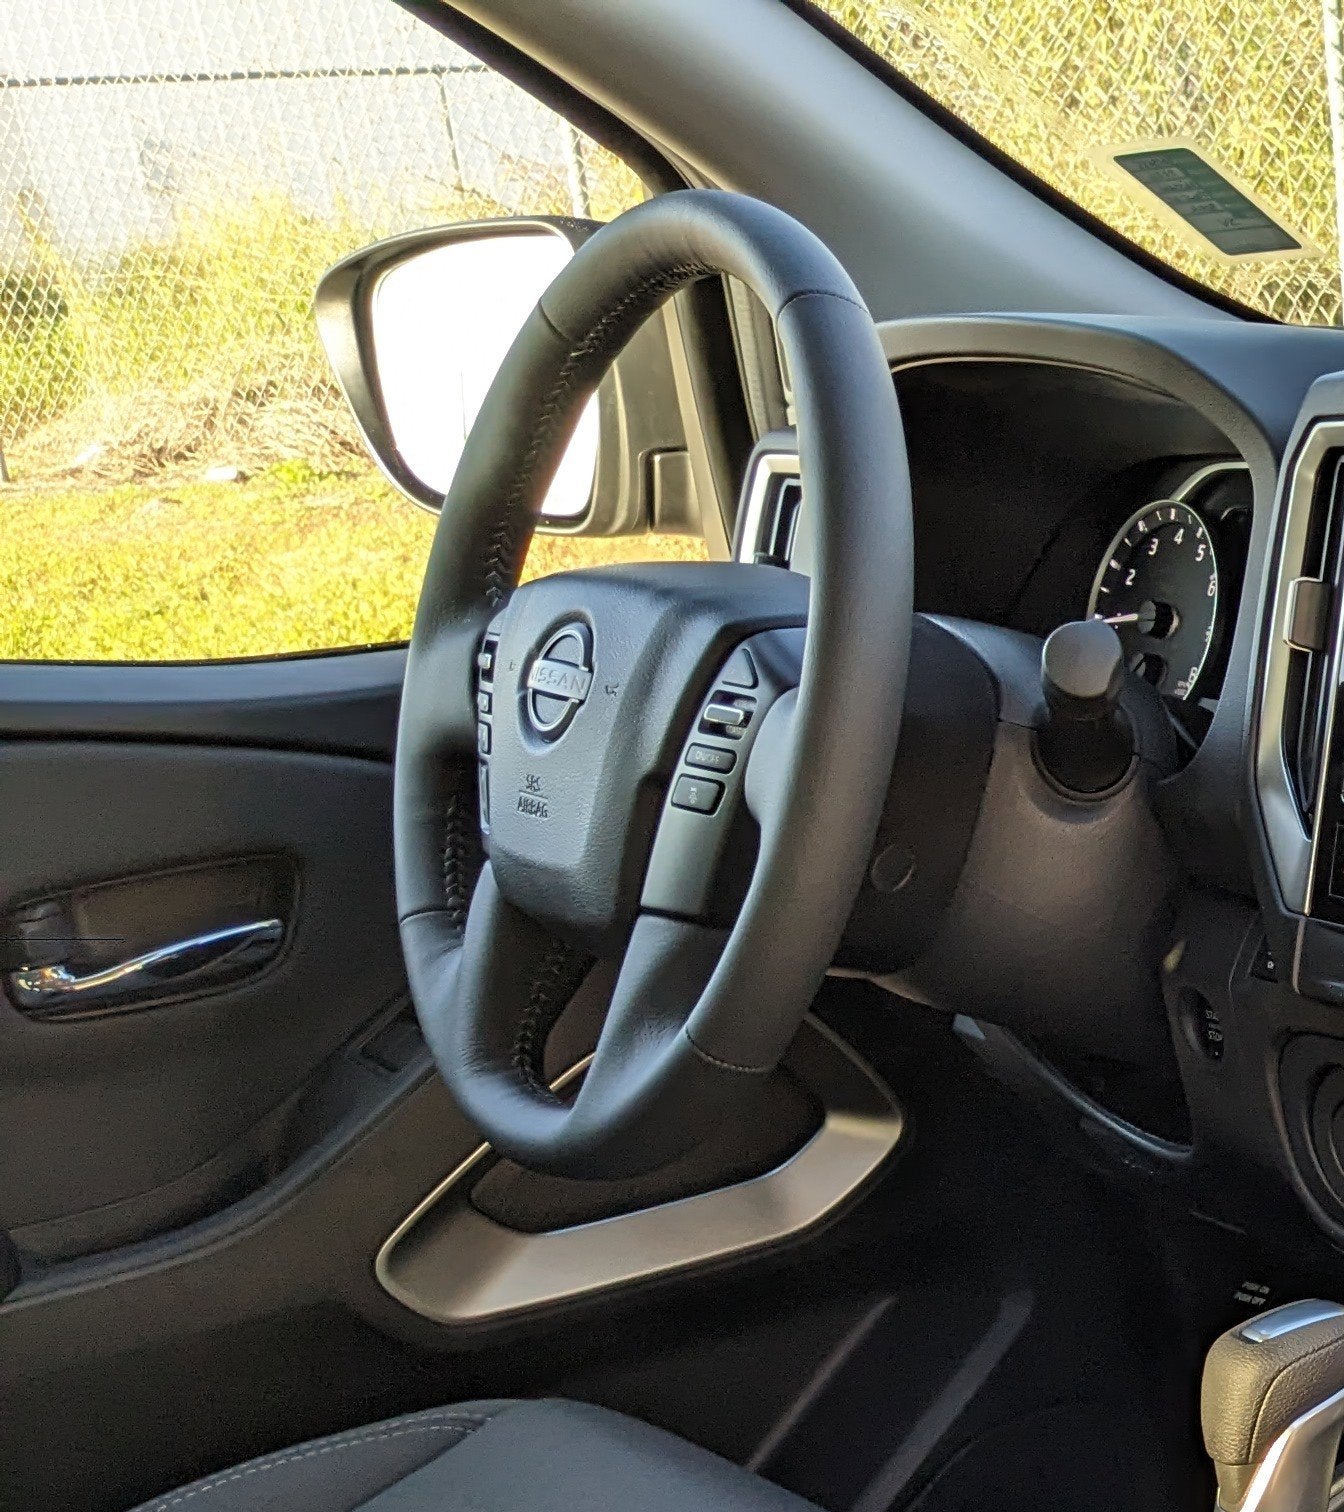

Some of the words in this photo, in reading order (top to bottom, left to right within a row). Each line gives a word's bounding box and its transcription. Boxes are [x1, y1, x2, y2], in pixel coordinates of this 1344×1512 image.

[1173, 528, 1185, 545] 4
[1148, 538, 1159, 555] 3
[1195, 543, 1207, 562] 5
[1125, 568, 1136, 586] 2
[531, 666, 588, 694] ISSAN
